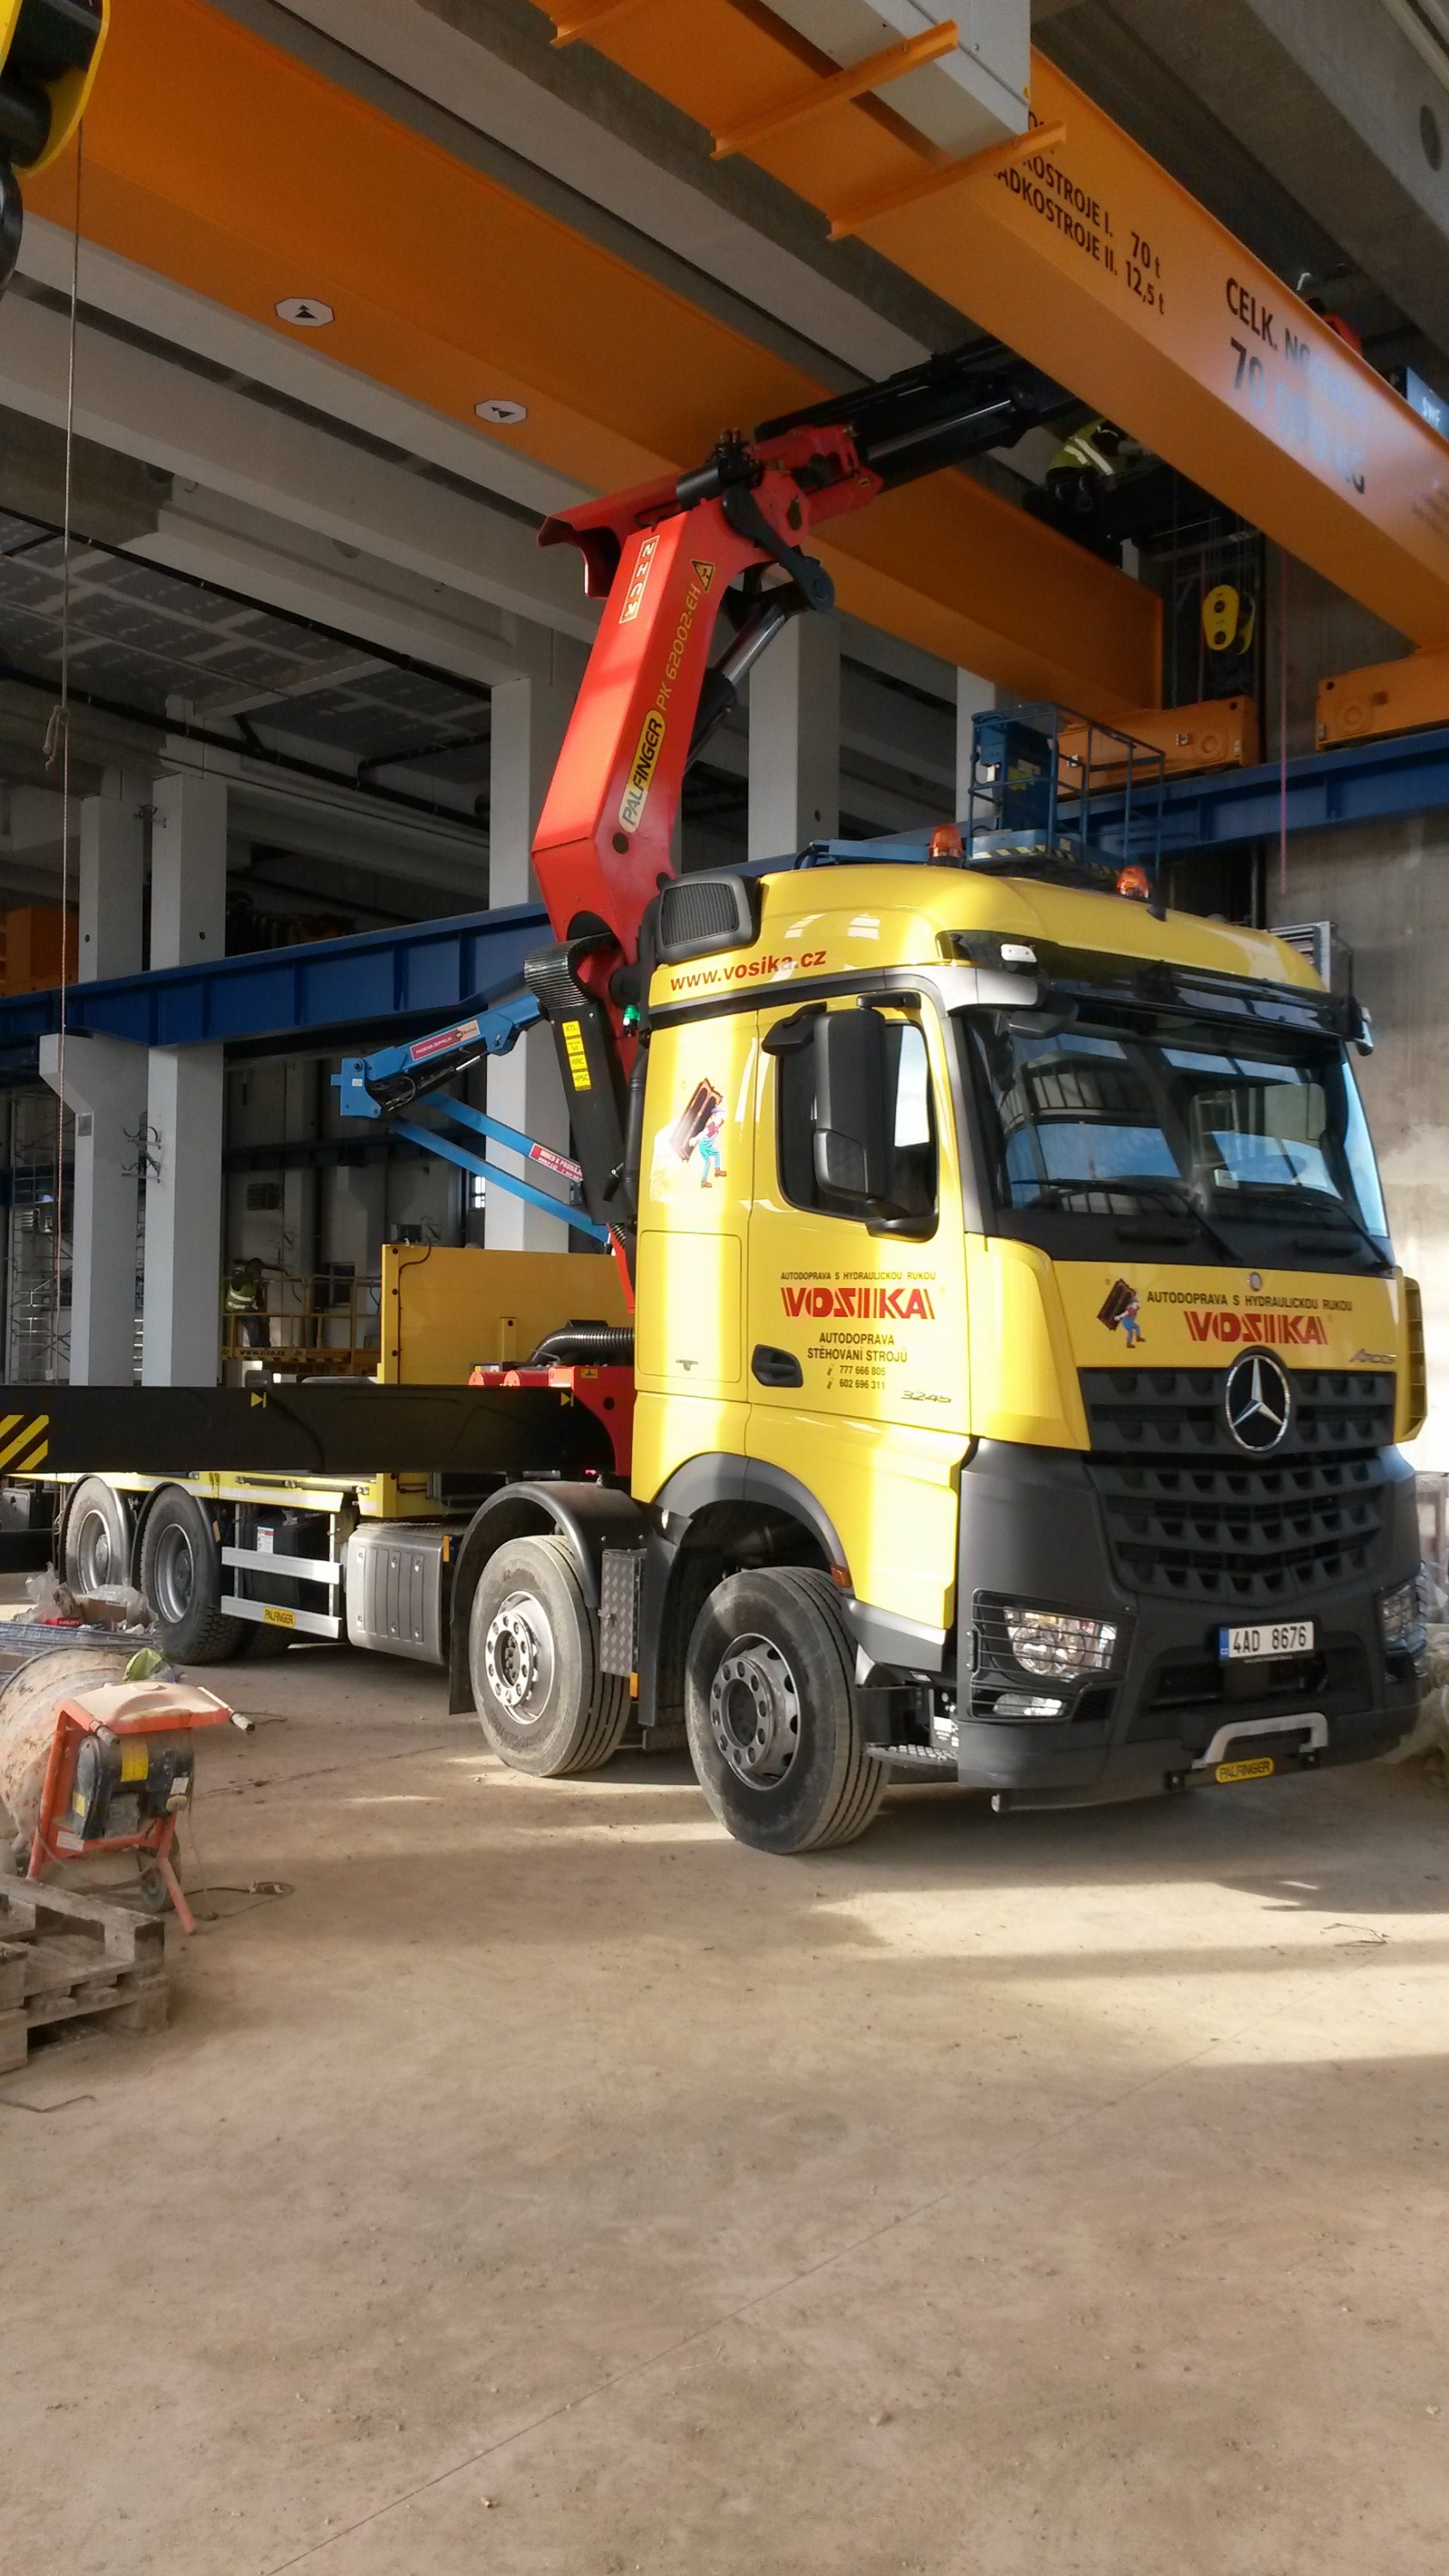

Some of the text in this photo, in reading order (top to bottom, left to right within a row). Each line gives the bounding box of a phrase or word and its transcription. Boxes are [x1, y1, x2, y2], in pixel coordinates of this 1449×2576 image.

[1023, 155, 1100, 227] OSTROJE
[1131, 230, 1151, 268] 70
[1154, 257, 1160, 279] t
[995, 167, 1100, 262] ADKOSTROJE
[1126, 260, 1154, 306] 12,5
[1159, 293, 1165, 316] t
[1226, 277, 1278, 351] CELK.
[1230, 336, 1267, 410] 70
[623, 583, 701, 826] PALFINGER PK 62002-EH
[670, 950, 827, 992] www.vosika.cz
[781, 1272, 936, 1280] AUTODOPRAVA S HYDRAULICKOU RUKOU
[1147, 1291, 1353, 1312] AUTODOPRAVA S HYDRAULICKOU RUKOU
[819, 1332, 895, 1346] AUTODOPRAVA
[839, 1364, 886, 1376] 777 666 805
[839, 1378, 886, 1390] 602 696 311
[1233, 1630, 1260, 1654] 4AD
[1271, 1625, 1306, 1650] 8676
[1219, 1760, 1272, 1780] PALFINGER
